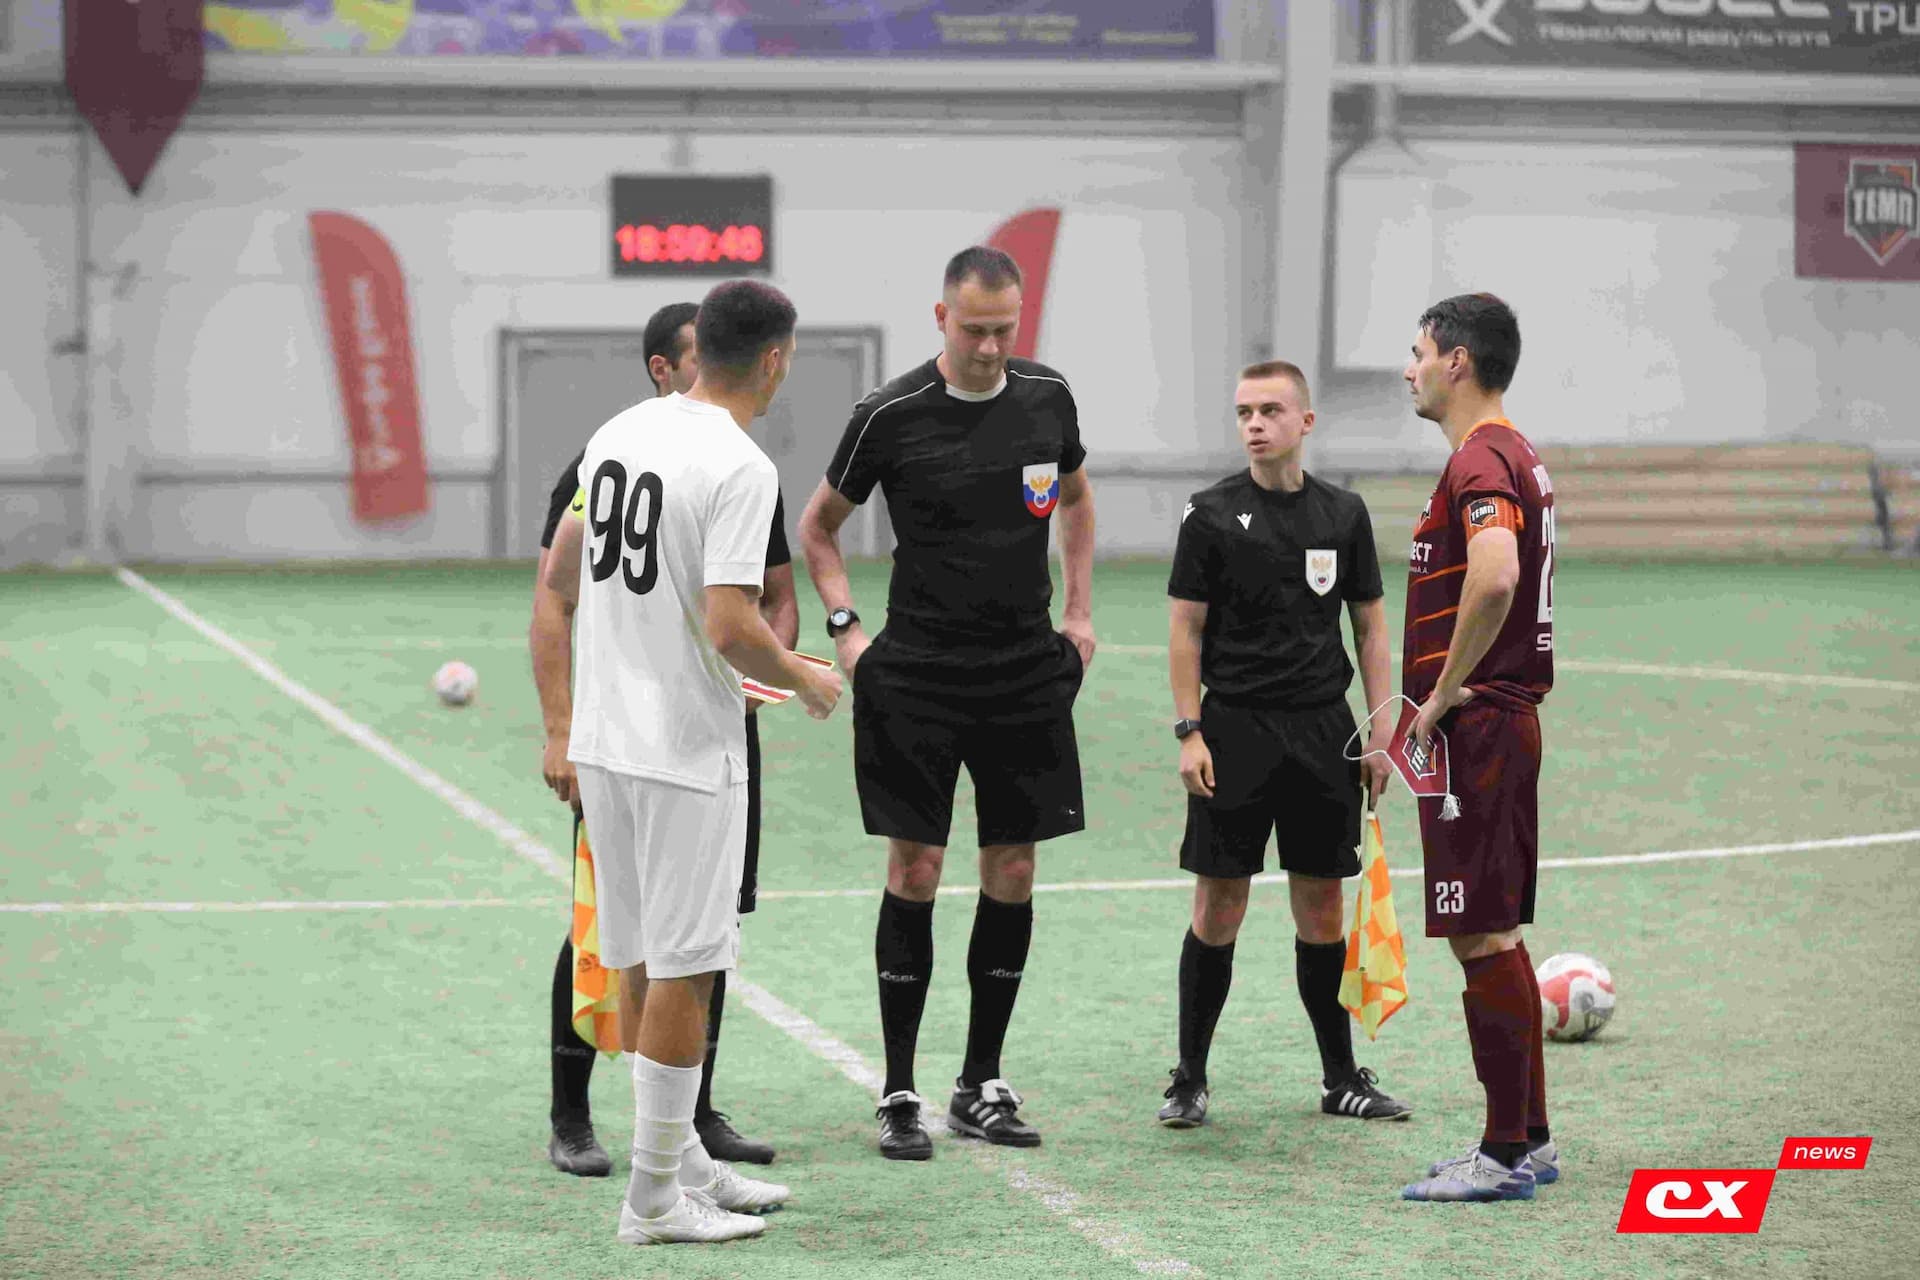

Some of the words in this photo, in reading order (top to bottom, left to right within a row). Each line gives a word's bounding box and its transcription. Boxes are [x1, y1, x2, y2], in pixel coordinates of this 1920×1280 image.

[590, 459, 663, 595] 99
[1471, 505, 1495, 521] ТЕМП
[1435, 880, 1465, 914] 23
